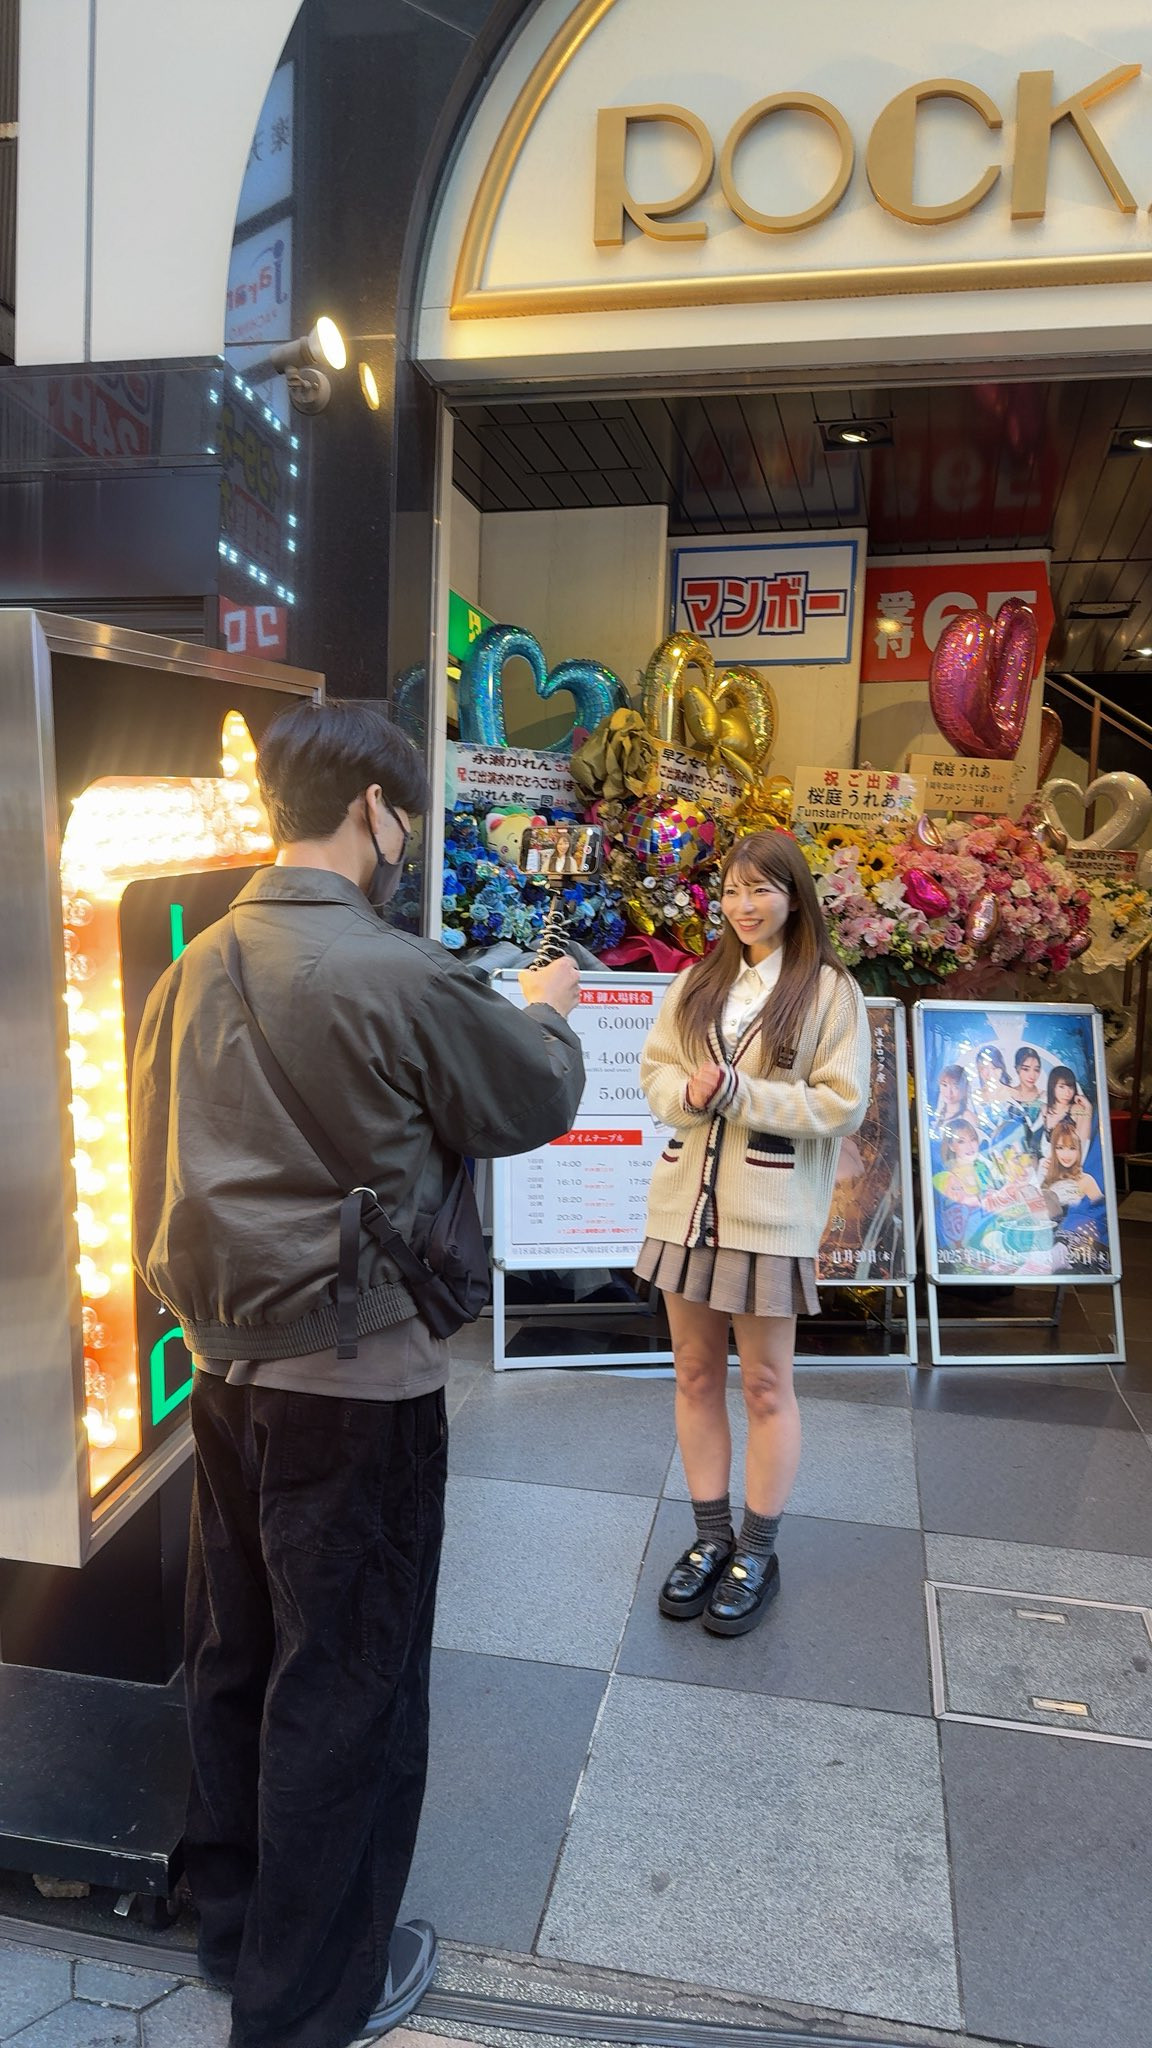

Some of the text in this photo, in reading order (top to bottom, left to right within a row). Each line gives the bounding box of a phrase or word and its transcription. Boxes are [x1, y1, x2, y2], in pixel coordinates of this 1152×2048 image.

[594, 64, 1152, 246] ROCK
[681, 571, 848, 637] マンボー
[876, 590, 915, 659] 受付
[568, 1133, 625, 1143] タイムテーブル
